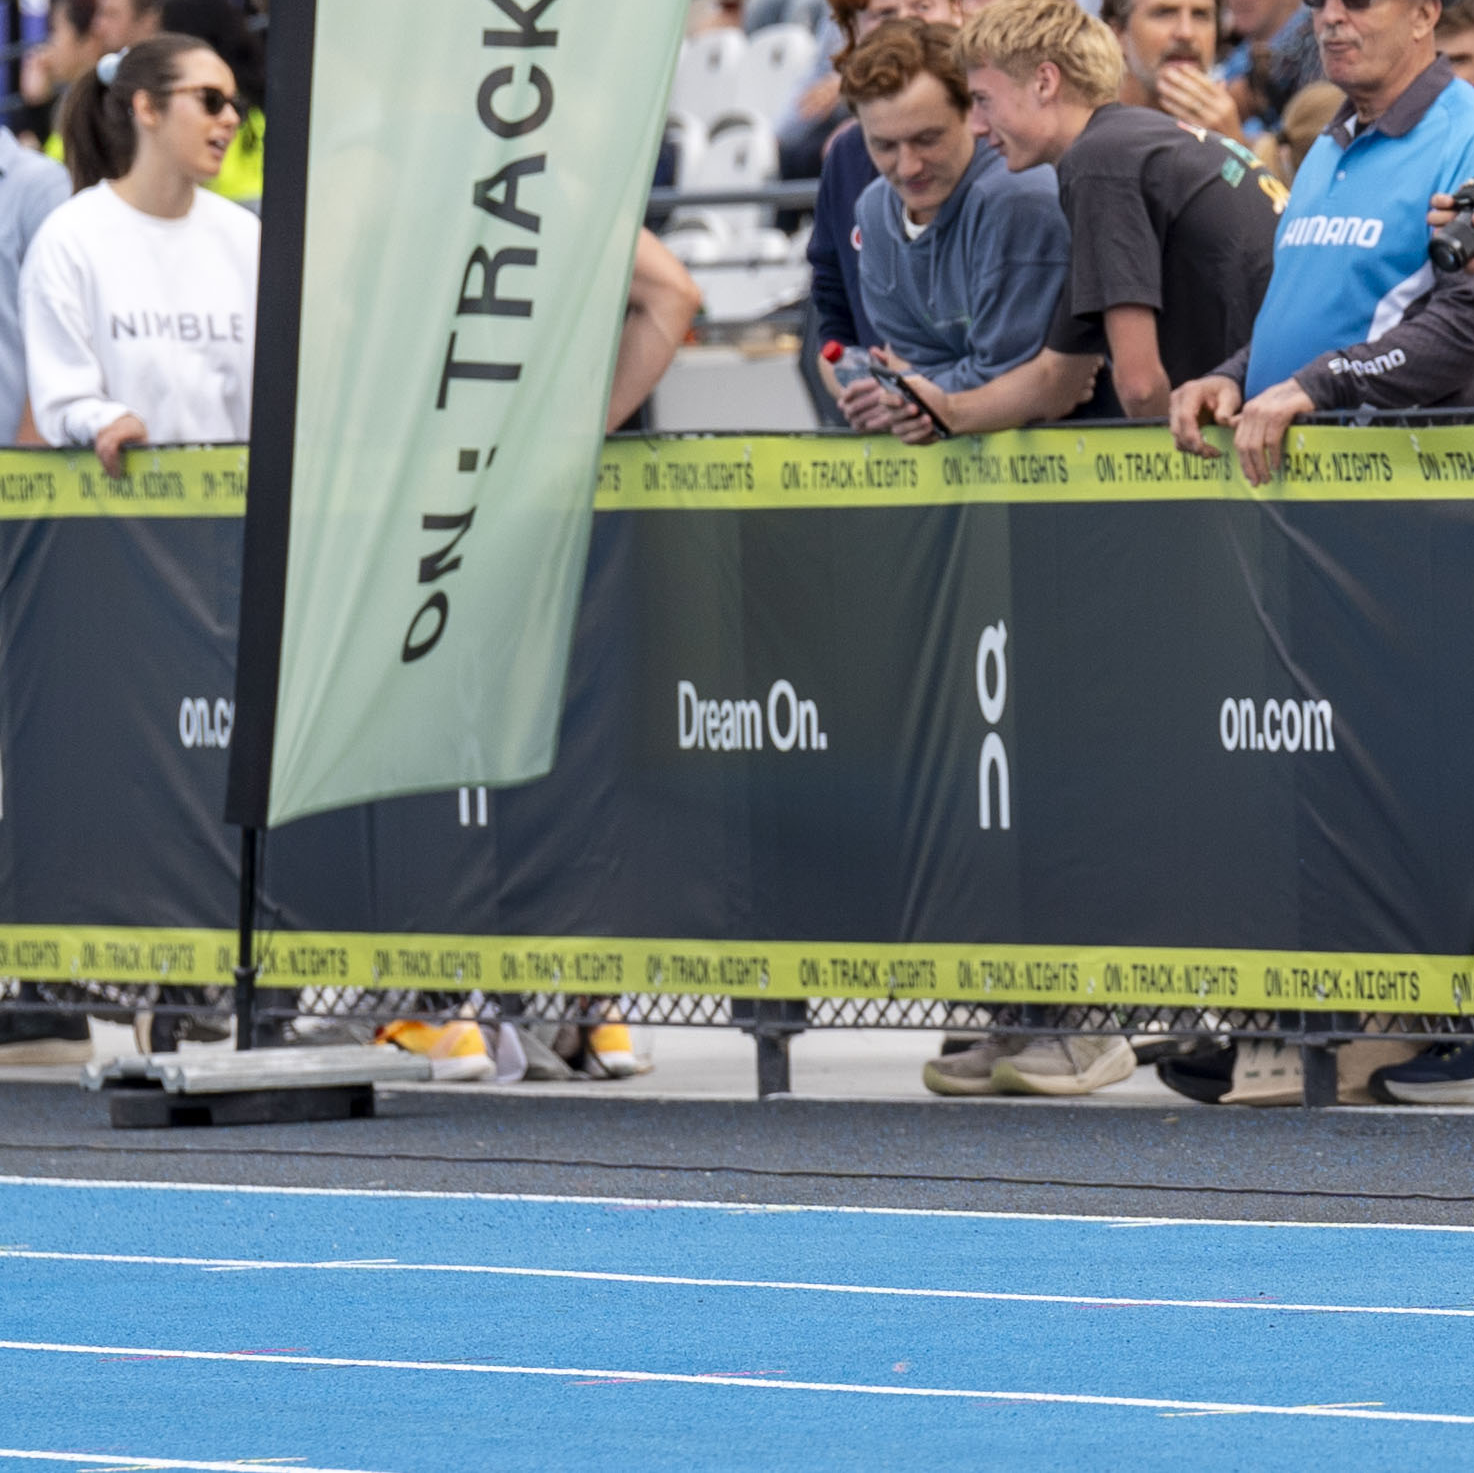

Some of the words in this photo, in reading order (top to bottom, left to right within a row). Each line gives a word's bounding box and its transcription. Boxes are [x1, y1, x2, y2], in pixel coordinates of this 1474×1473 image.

[110, 311, 243, 344] NIMBLE
[643, 461, 755, 491] ON:TRACK:NIGHTS
[781, 457, 917, 490] ON:TRACK:NIGHTS
[678, 680, 763, 751] Dream
[768, 678, 829, 752] On.
[1220, 697, 1336, 752] on.com
[501, 952, 624, 983] ON:TRACK:NIGHTS
[799, 958, 937, 990] ON:TRACK:NIGHTS
[957, 958, 1079, 992] ON:TRACK:NIGHTS
[1104, 963, 1239, 997] ON:TRACK:NIGHTS
[1263, 967, 1421, 1002] ON:TRACK:NIGHTS
